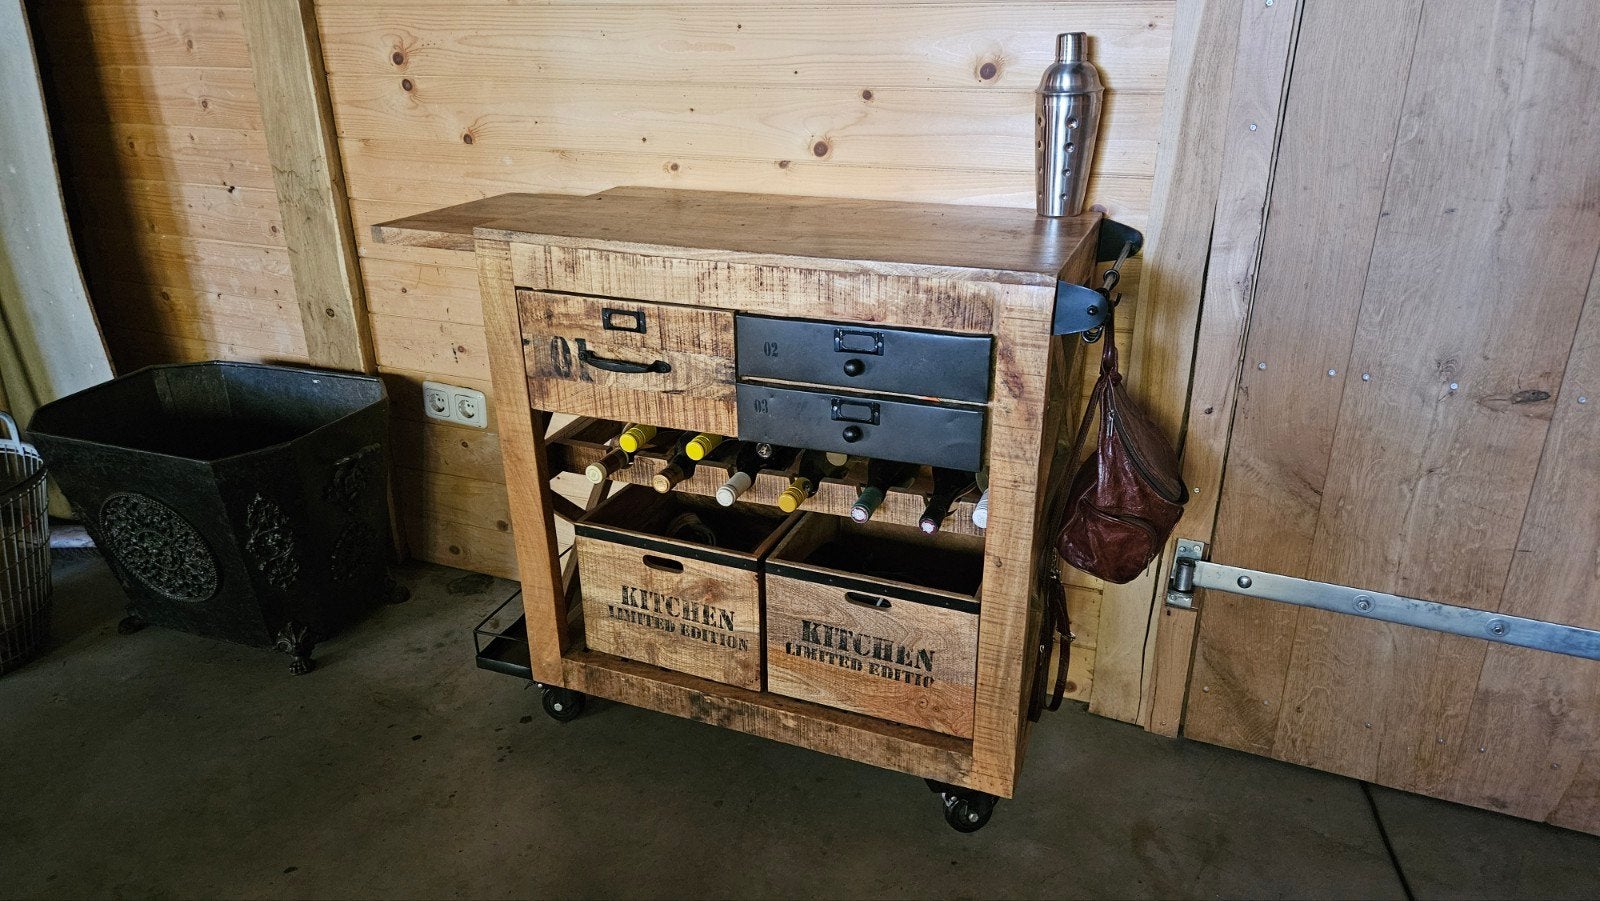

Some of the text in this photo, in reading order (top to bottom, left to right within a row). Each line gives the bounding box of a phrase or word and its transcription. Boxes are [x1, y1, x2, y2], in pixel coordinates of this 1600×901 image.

[763, 341, 779, 358] 02
[754, 399, 769, 414] 03
[622, 585, 735, 632] KITCHEN
[608, 605, 749, 651] LIMITED EDITION
[802, 620, 936, 672] KITCHEN
[785, 642, 864, 671] LIMITED
